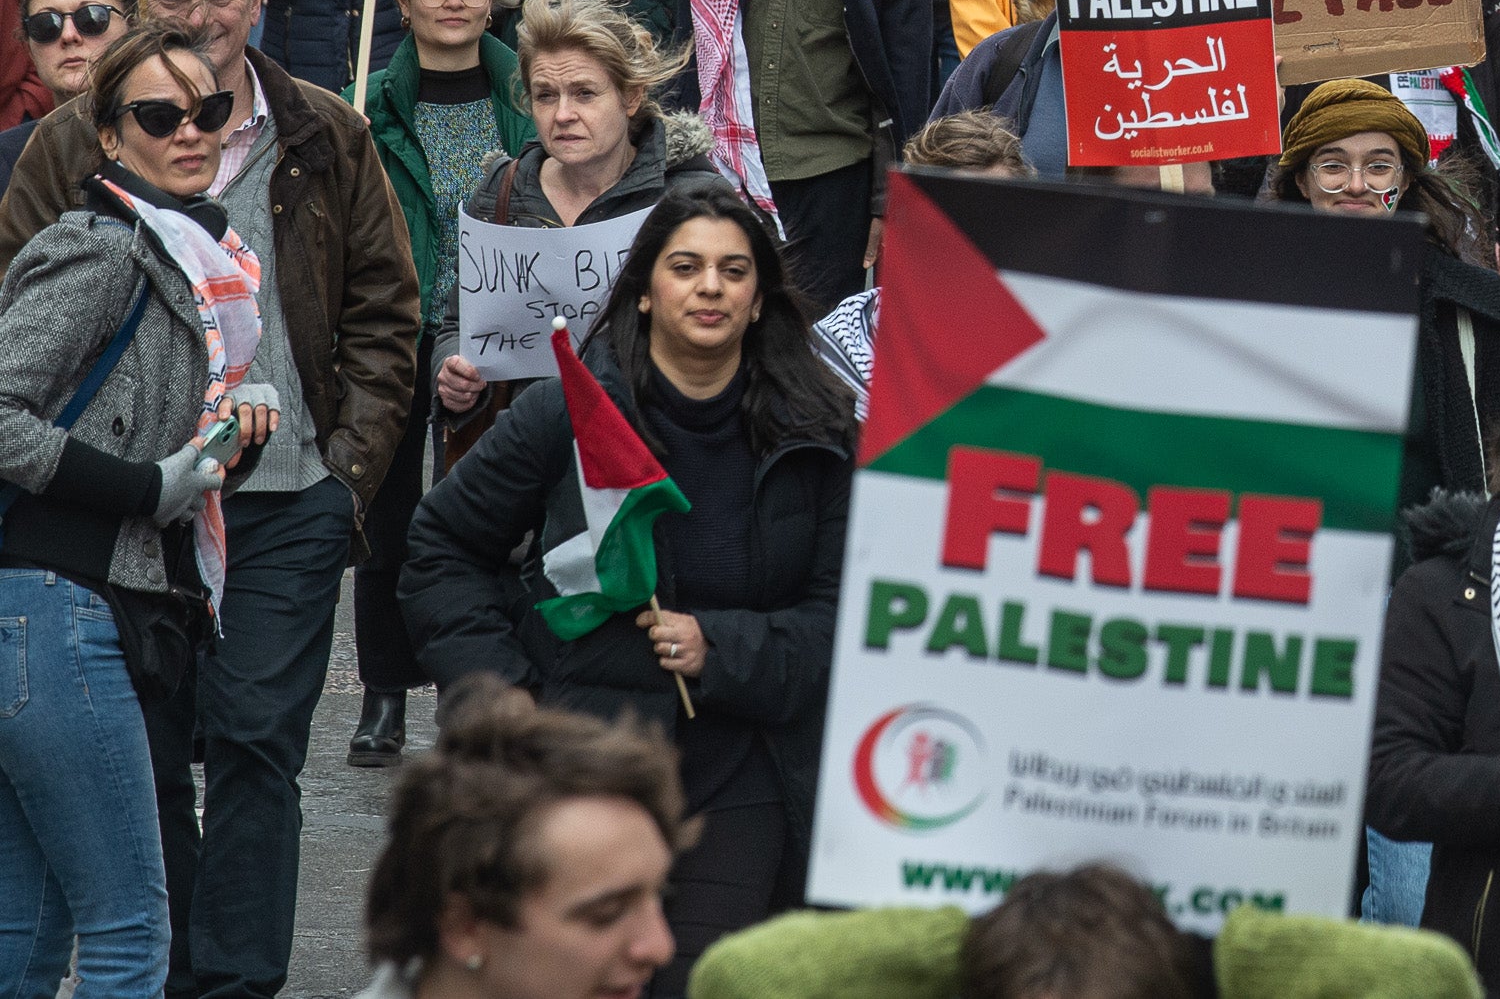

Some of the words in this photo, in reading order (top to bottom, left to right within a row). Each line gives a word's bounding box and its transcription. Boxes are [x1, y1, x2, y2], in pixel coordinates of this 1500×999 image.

[1102, 36, 1227, 90] الحرية
[1397, 75, 1410, 89] FR
[1409, 76, 1449, 90] PALESTI
[1094, 82, 1250, 142] لفلسطين
[1130, 142, 1214, 160] socialistworker.co.uk
[460, 230, 552, 296] SUNAK
[526, 299, 602, 320] STOP
[470, 331, 541, 356] THE
[940, 445, 1323, 605] FREE
[862, 580, 1360, 700] PALESTINE
[1003, 782, 1139, 822] Palestinian
[1143, 801, 1223, 830] Forum
[1227, 810, 1250, 832] in
[1258, 810, 1342, 840] Britain
